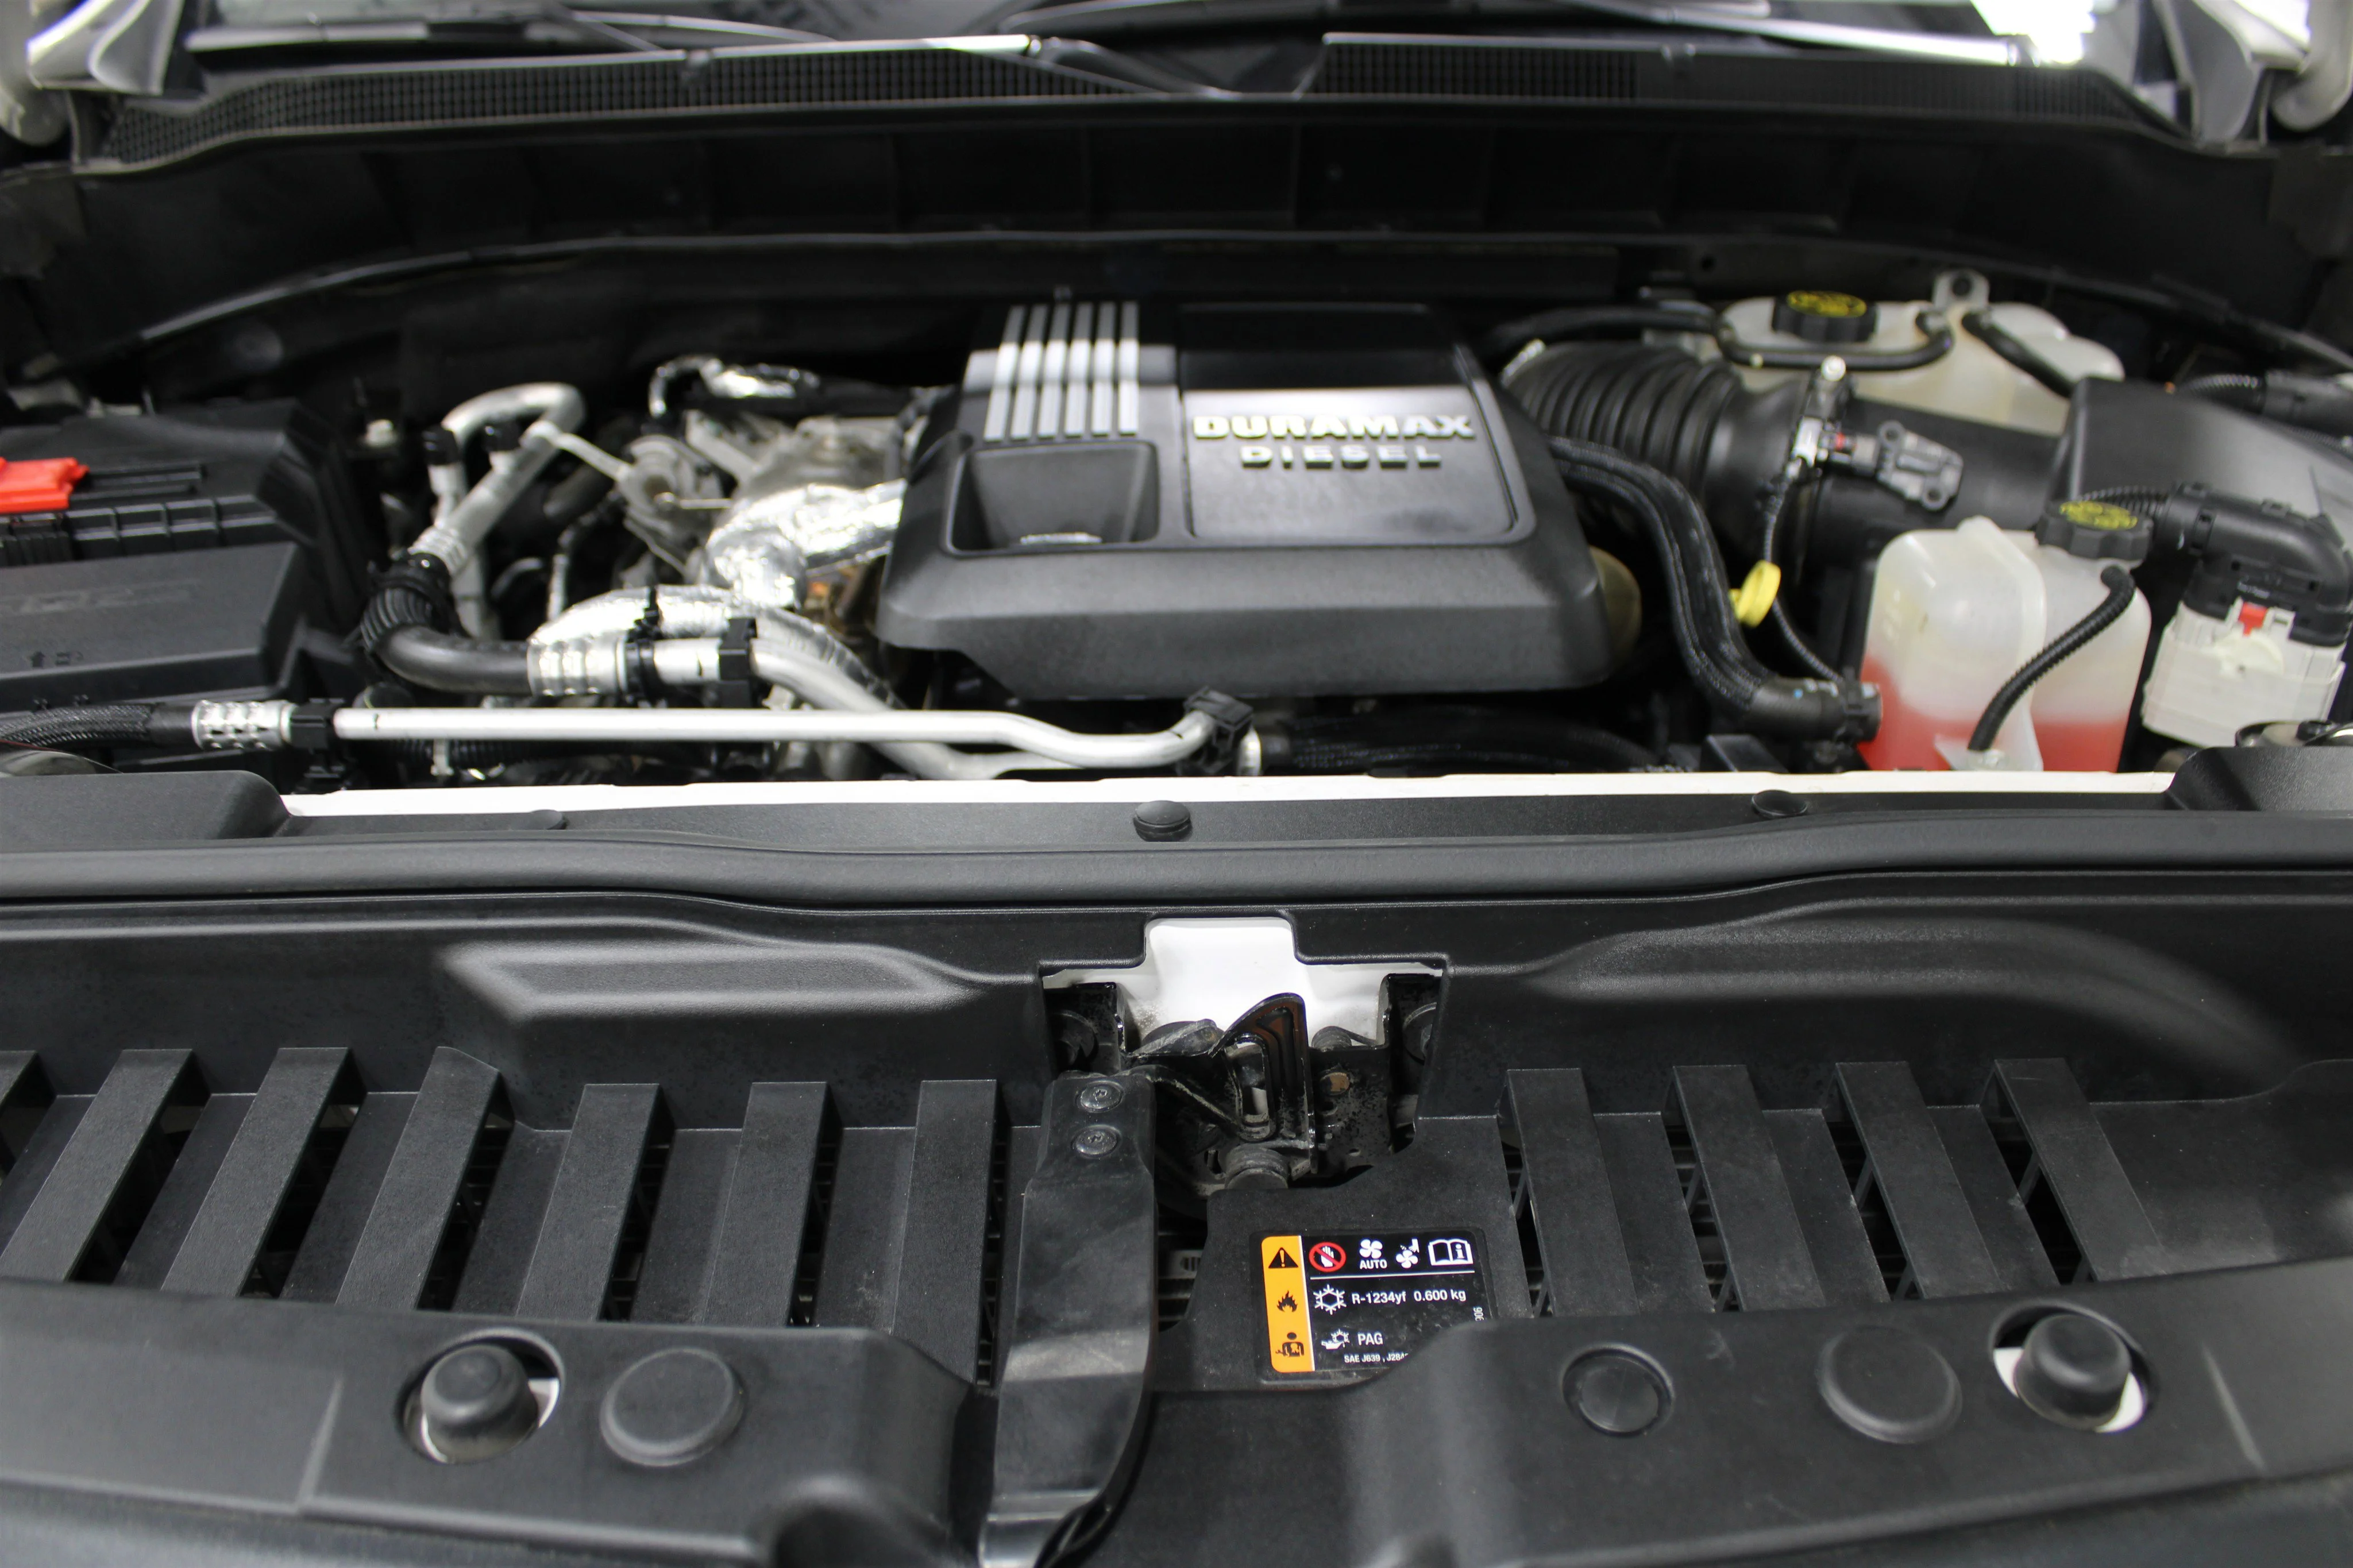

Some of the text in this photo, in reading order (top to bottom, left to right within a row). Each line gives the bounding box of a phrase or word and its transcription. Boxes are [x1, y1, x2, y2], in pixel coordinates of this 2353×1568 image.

[1193, 415, 1475, 438] DURAMAX
[1240, 445, 1440, 468] DIESEL
[1359, 1259, 1387, 1269] AUTO
[1352, 1289, 1467, 1305] R-1234yf 0.600 kg
[1357, 1333, 1383, 1345] PAG
[1344, 1354, 1360, 1363] SAE
[1386, 1351, 1409, 1362] J284
